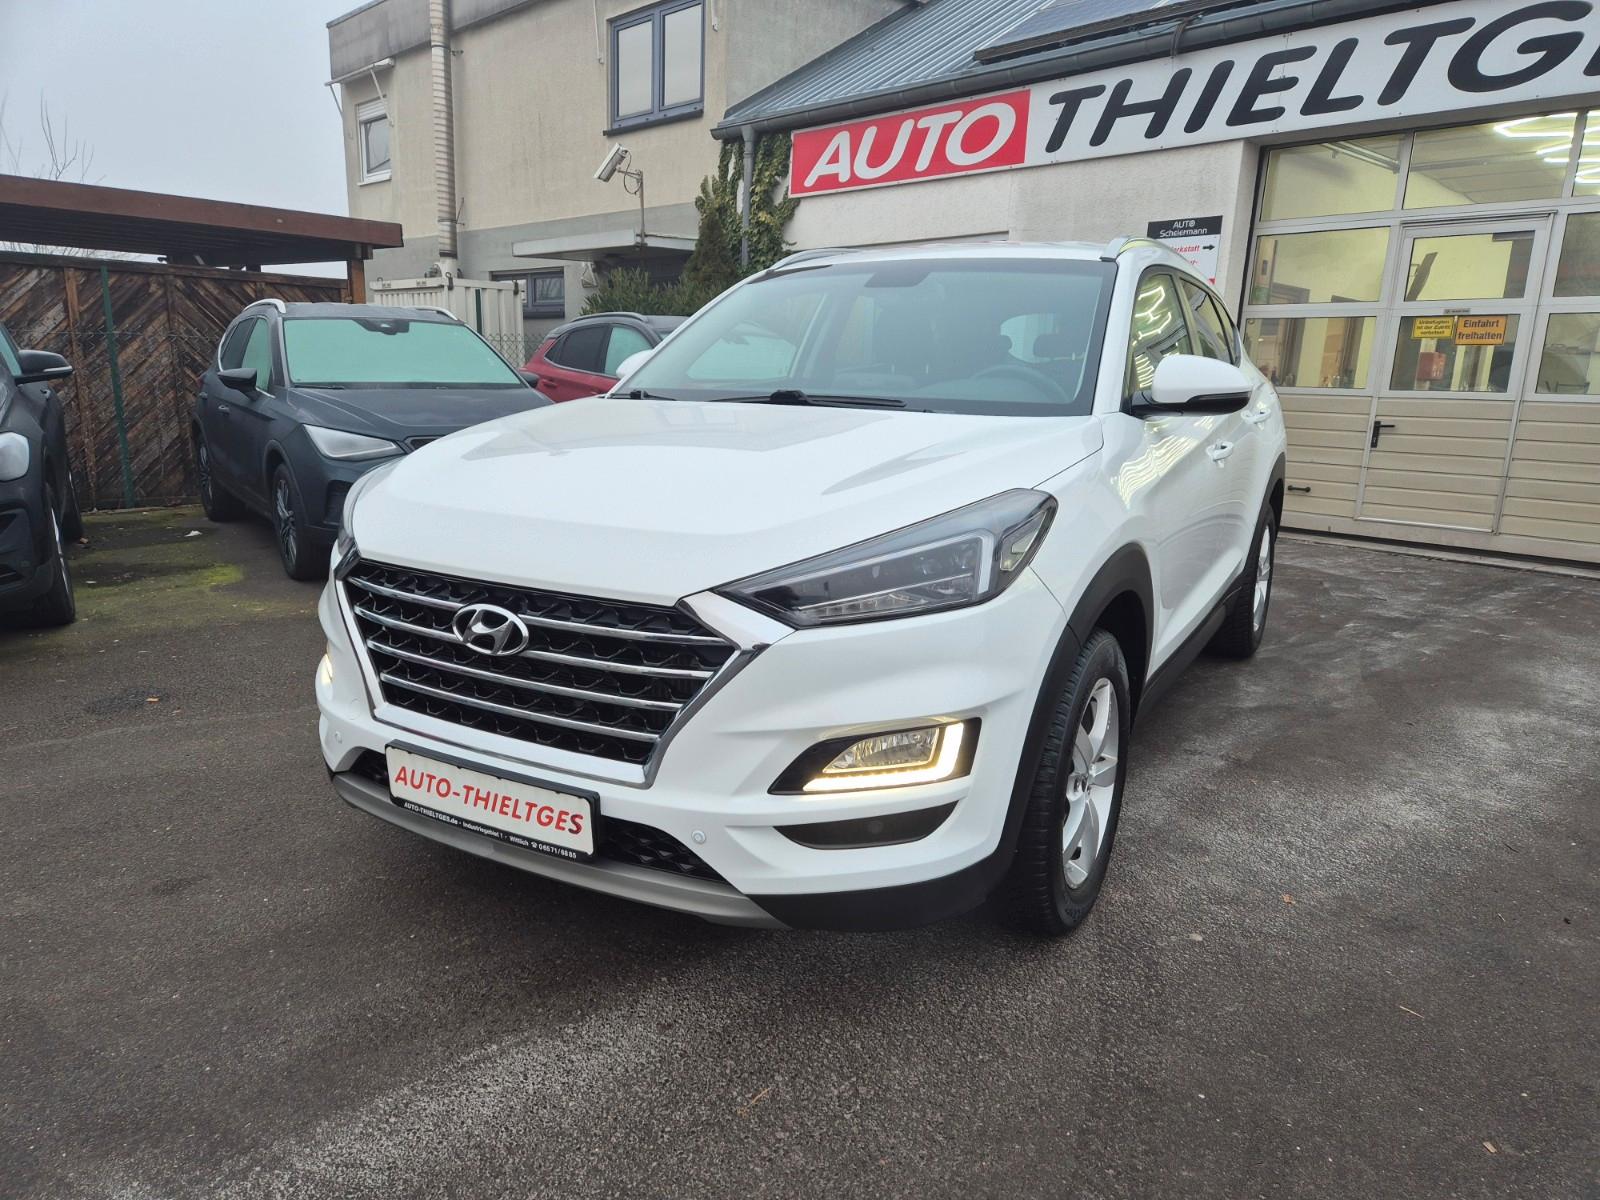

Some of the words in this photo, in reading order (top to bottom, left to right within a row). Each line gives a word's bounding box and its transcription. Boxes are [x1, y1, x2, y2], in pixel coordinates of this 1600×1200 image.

[804, 100, 1017, 188] AUTO
[1045, 0, 1600, 153] THIELTG
[1172, 219, 1196, 229] AUTO
[1463, 319, 1500, 328] Einfahrt
[1457, 331, 1503, 340] freihalten
[394, 765, 584, 836] AUTO-THIELTGES
